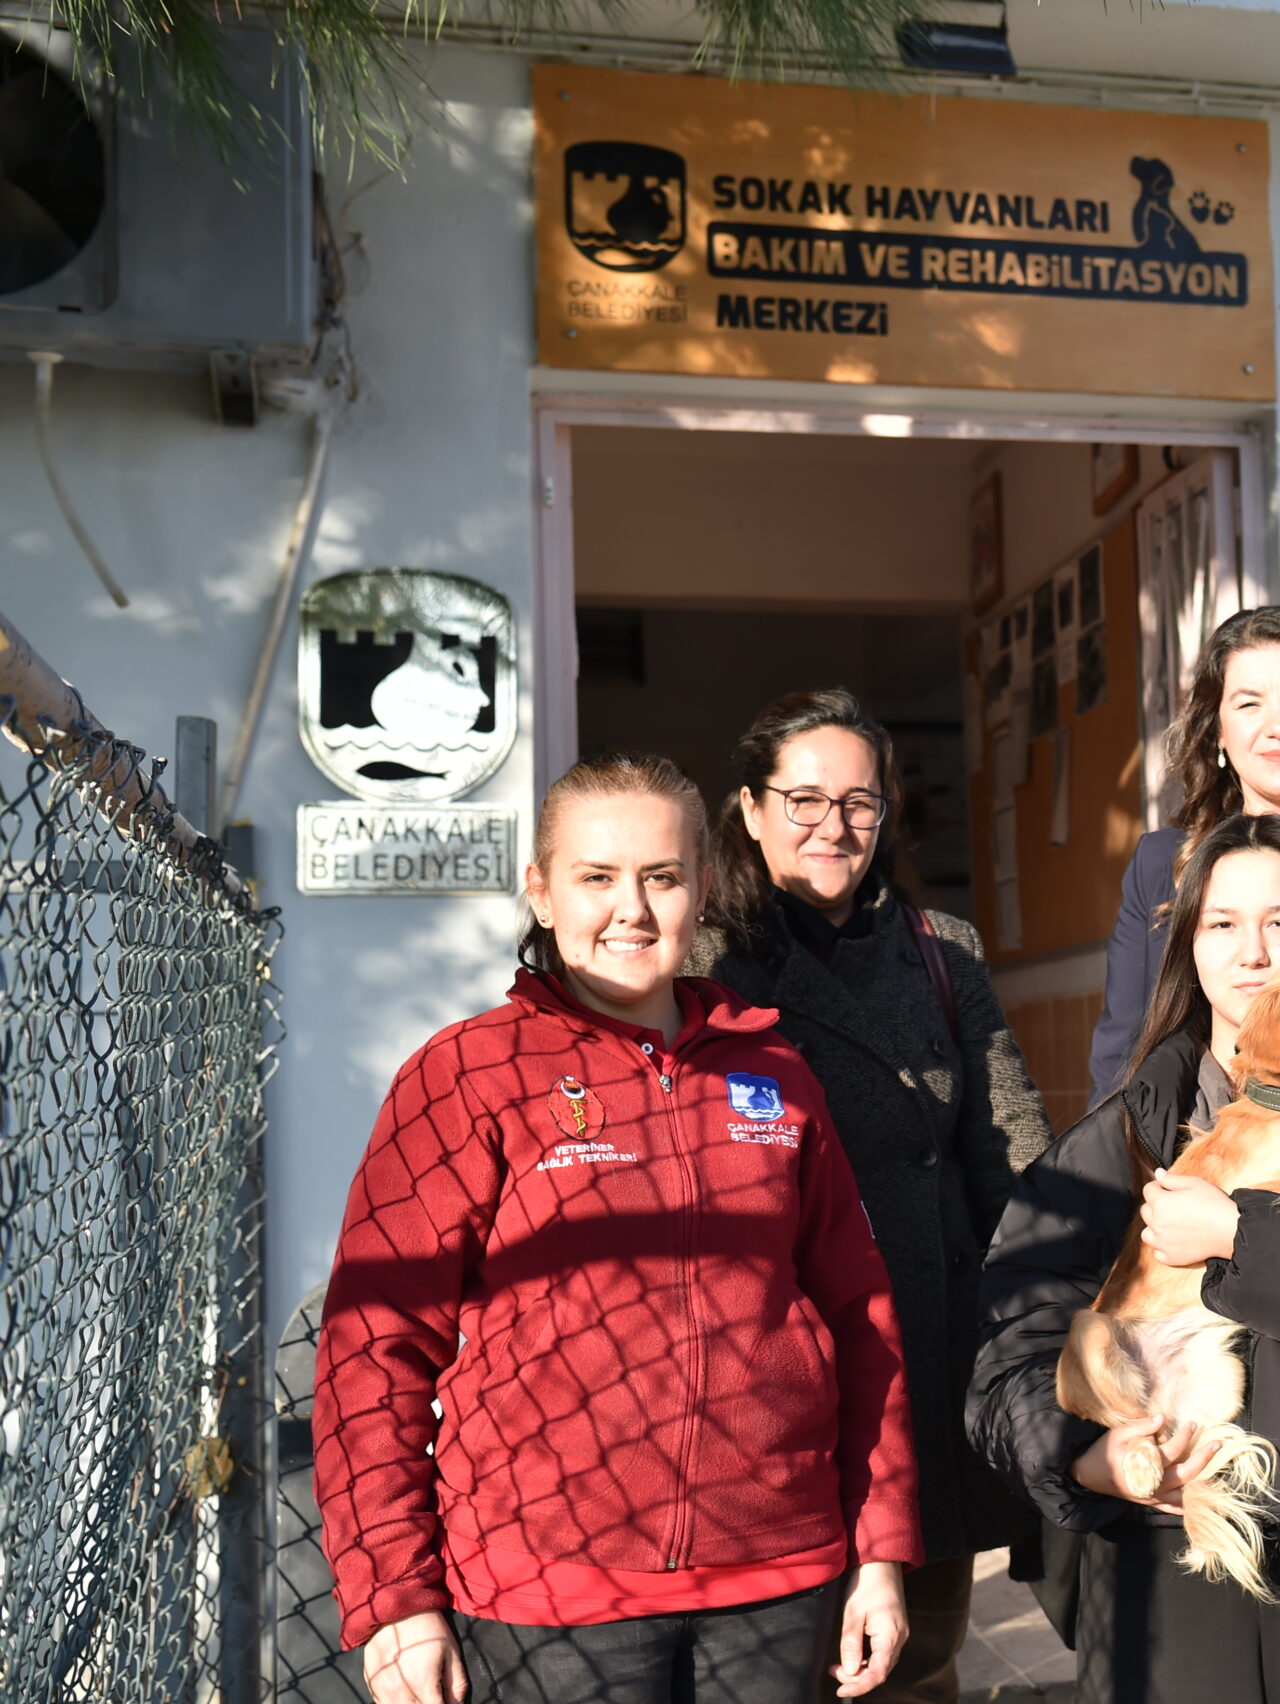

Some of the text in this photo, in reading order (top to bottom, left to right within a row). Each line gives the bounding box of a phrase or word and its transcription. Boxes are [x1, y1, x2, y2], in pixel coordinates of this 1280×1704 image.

[713, 175, 1110, 233] SOKAK HAYVANLARI
[712, 233, 847, 276] BAKIM
[860, 243, 910, 279] VE
[310, 814, 501, 848] ÇANAKKALE
[311, 848, 503, 882] BELEDİYESİ
